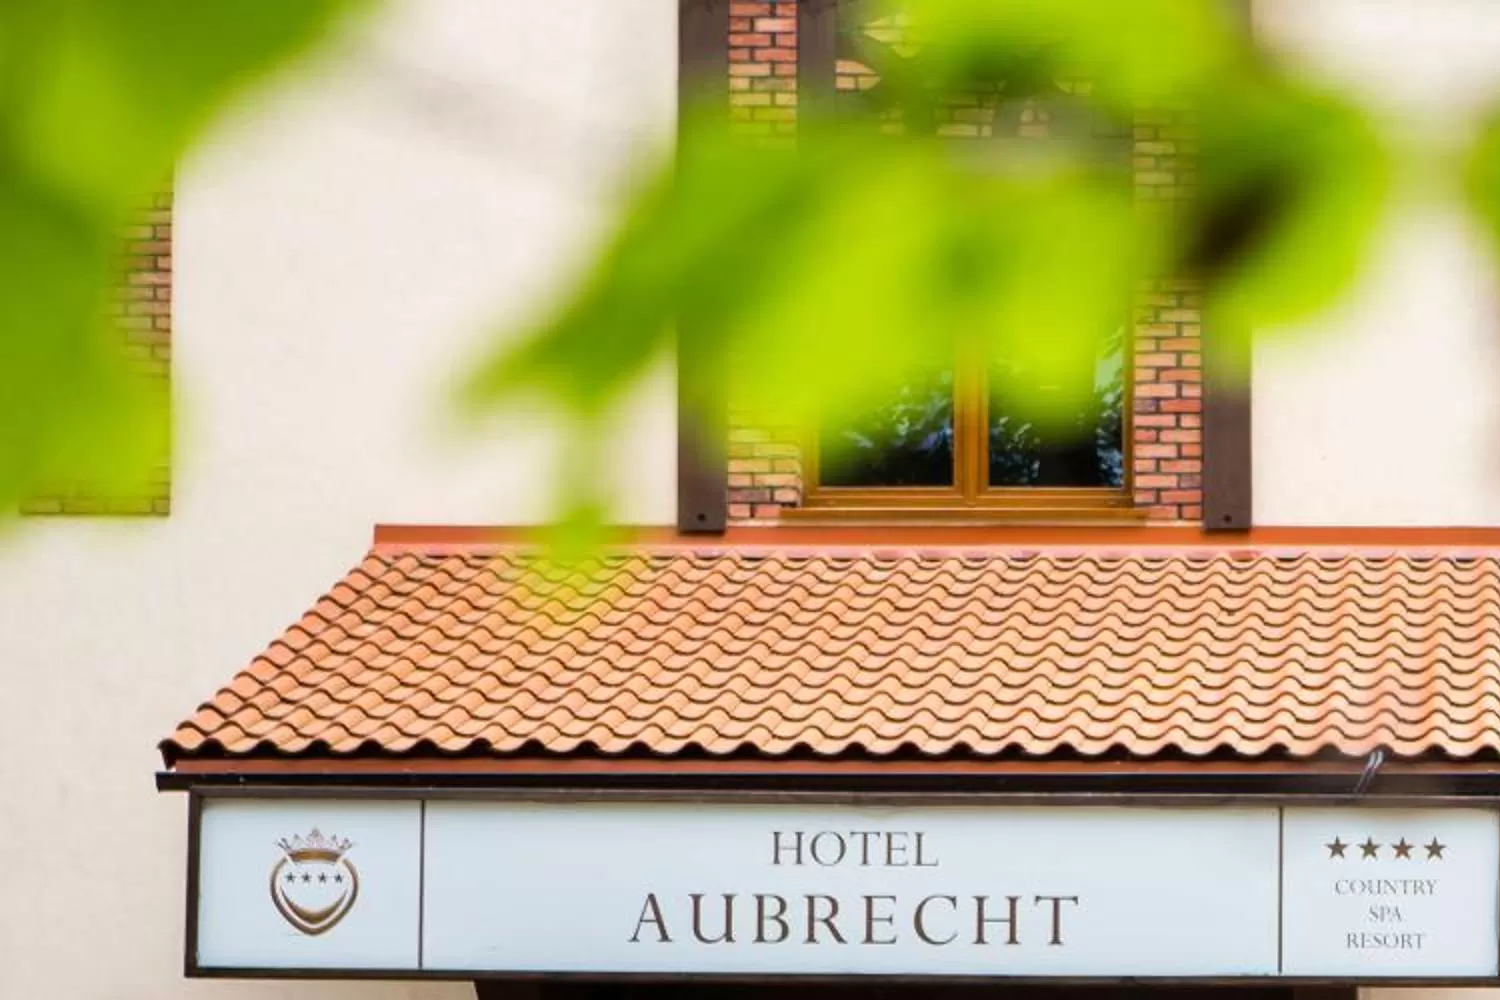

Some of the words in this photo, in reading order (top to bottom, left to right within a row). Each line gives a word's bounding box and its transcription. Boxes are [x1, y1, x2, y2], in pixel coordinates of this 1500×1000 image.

[772, 831, 939, 866] HOTEL
[1334, 878, 1438, 895] COUNTRY
[627, 892, 1080, 946] AUBRECHT
[1368, 904, 1402, 922] SPA
[1346, 931, 1424, 949] RESORT
